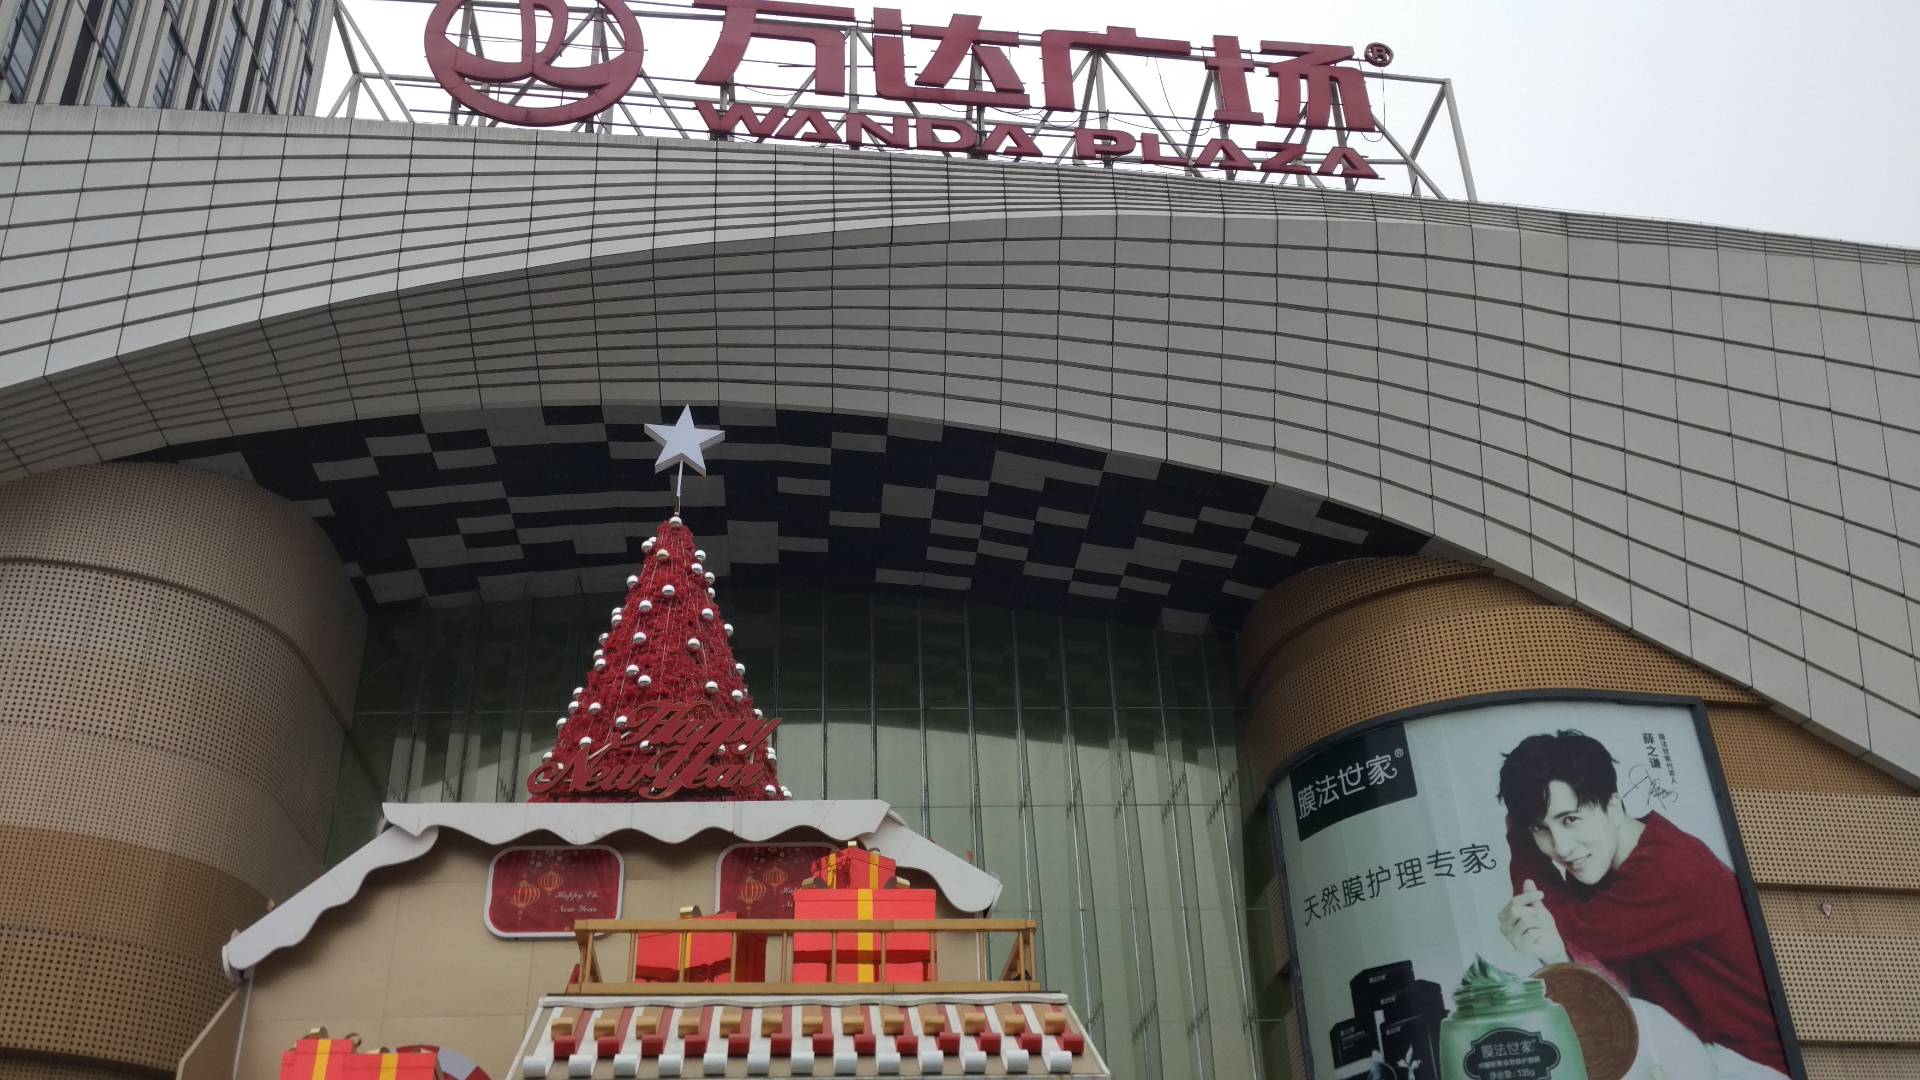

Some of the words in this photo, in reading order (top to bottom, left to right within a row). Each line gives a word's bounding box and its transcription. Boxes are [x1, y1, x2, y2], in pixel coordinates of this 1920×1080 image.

[693, 0, 1376, 133] 万达广场
[694, 98, 1044, 158] WANDA
[1073, 127, 1380, 180] PLAZA
[611, 700, 783, 757] Happy
[526, 747, 648, 794] New
[638, 744, 767, 800] Year
[1297, 754, 1398, 820] 膜法世家
[1303, 843, 1497, 927] 天然膜护理专家
